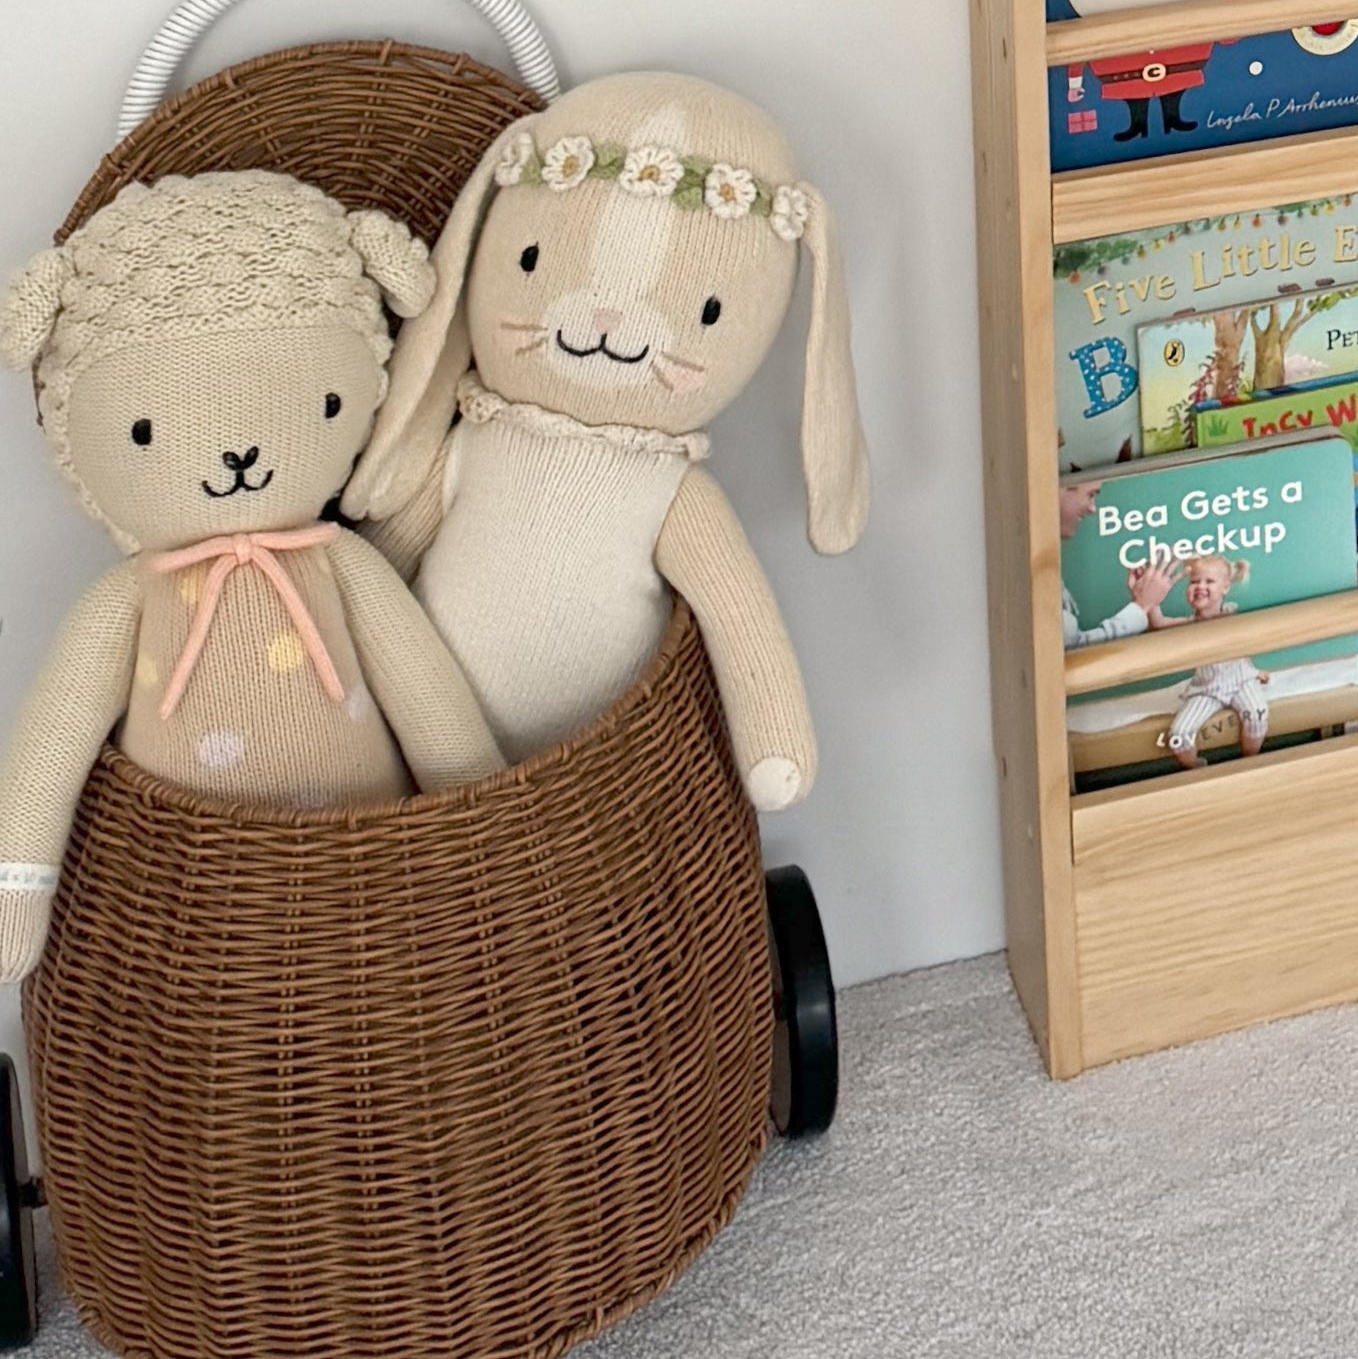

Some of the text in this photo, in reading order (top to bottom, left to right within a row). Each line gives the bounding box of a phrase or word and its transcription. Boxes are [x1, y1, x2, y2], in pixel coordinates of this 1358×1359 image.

[1097, 480, 1302, 538] Bea Gets a
